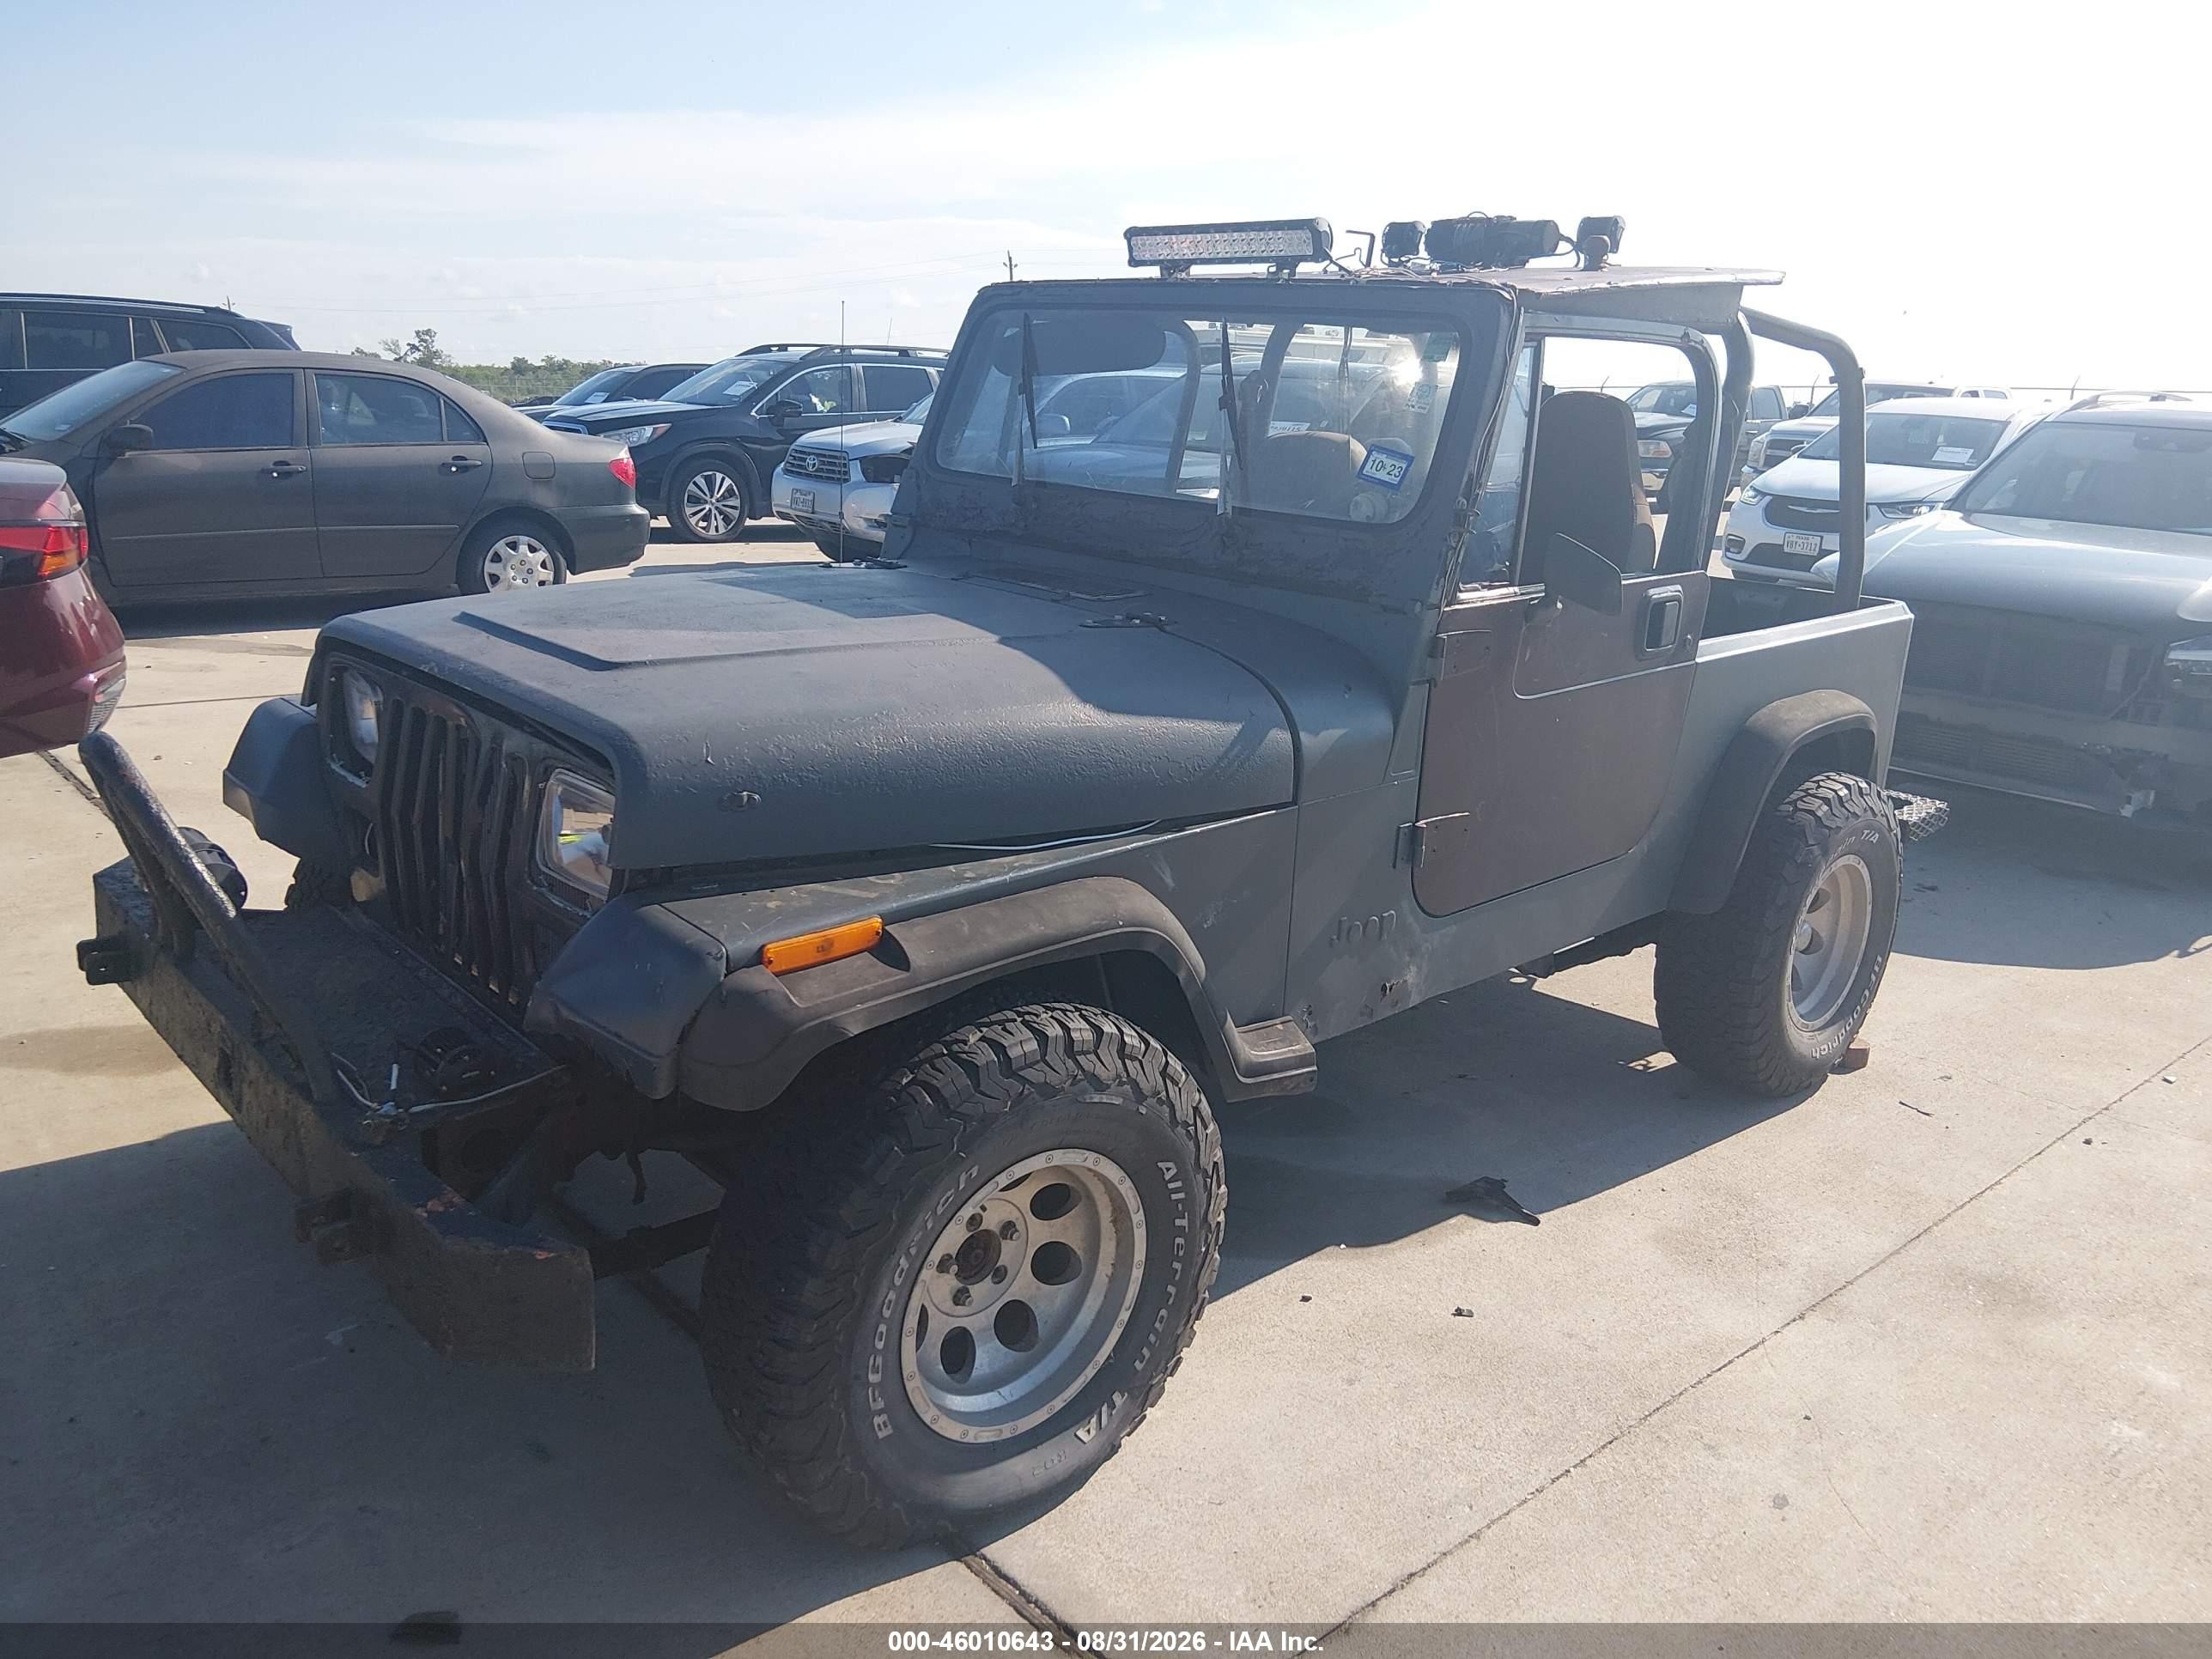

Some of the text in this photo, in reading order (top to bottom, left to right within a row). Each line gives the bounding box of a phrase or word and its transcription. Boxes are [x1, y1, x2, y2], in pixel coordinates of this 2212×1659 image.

[1370, 459, 1384, 472] 10
[1387, 464, 1403, 478] 23
[1861, 830, 1880, 843] T/A
[1811, 954, 1882, 1059] BFGoodrich
[868, 1164, 979, 1439] BFGoodrich
[1075, 1162, 1189, 1444] All-Terrain T/A
